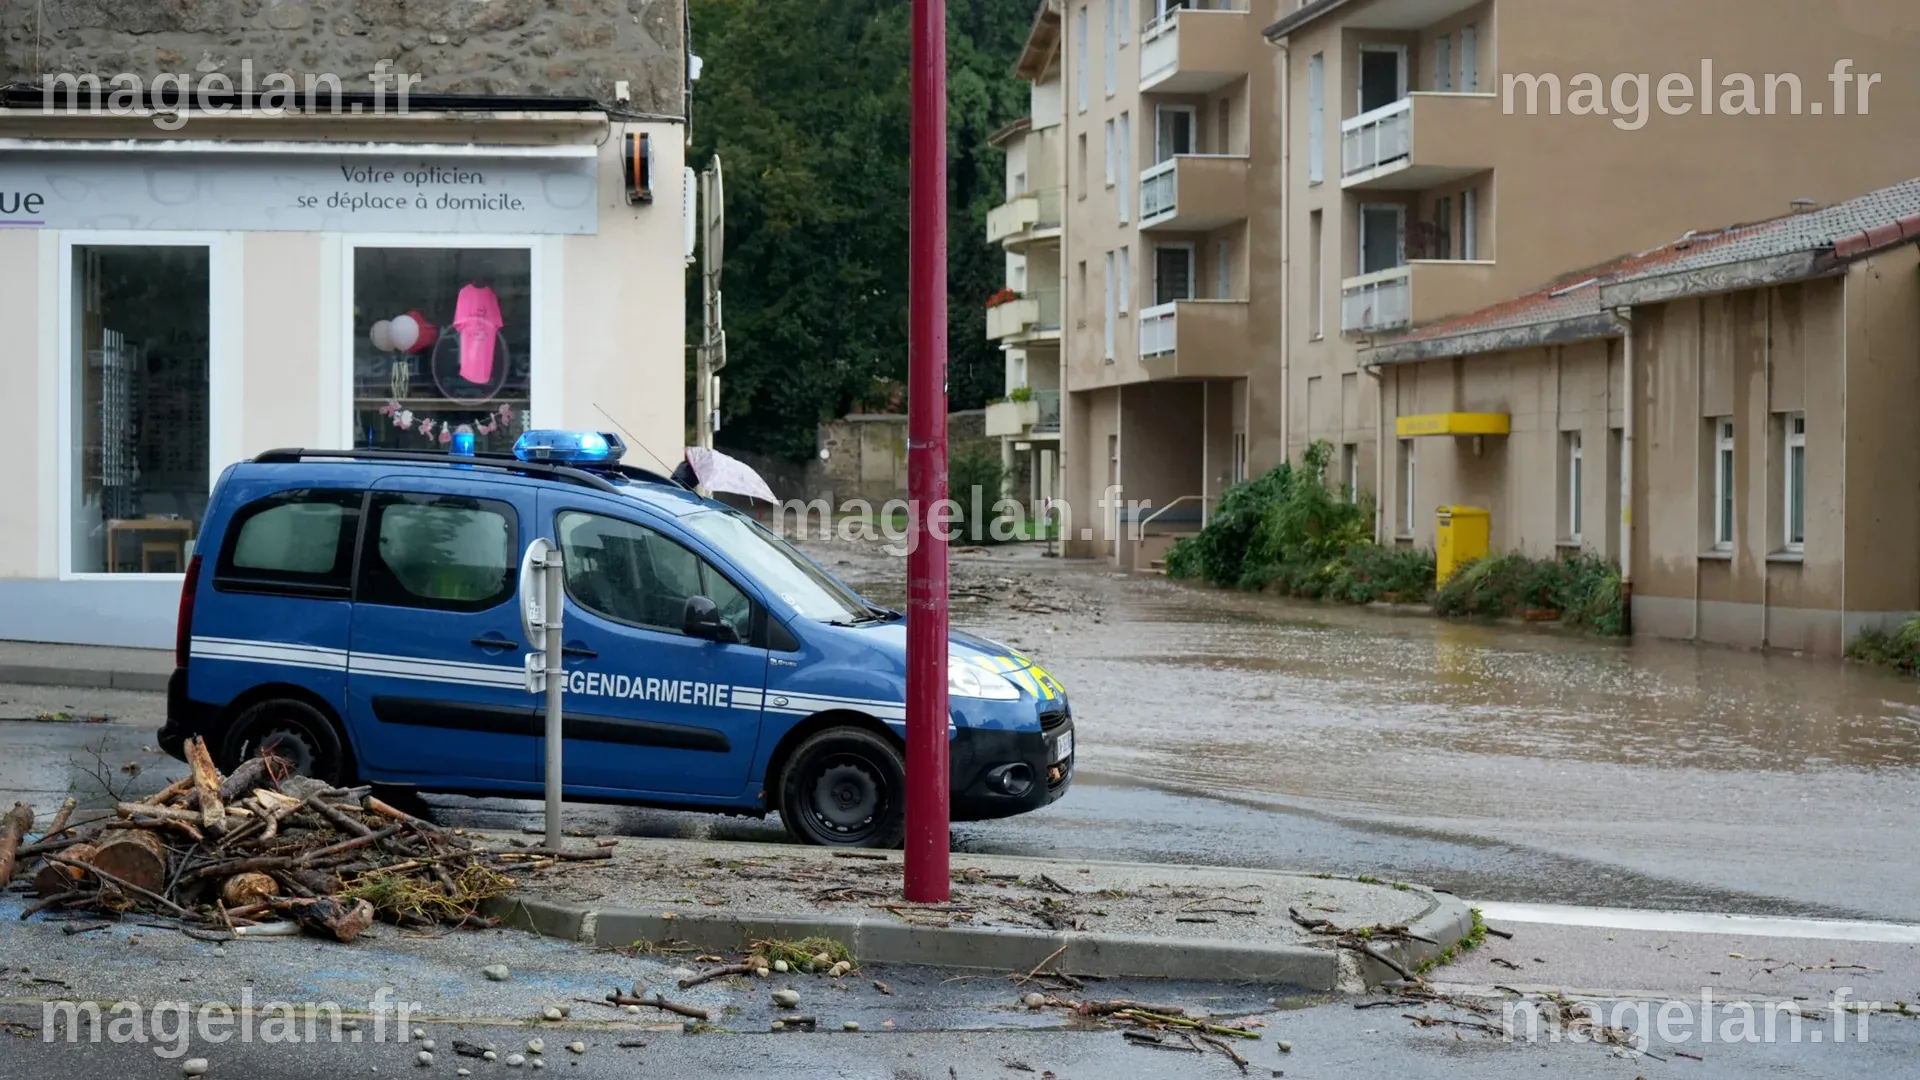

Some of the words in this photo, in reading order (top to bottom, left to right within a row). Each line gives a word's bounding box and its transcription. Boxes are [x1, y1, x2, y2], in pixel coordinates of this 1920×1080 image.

[340, 165, 395, 184] Votre
[403, 166, 483, 187] opticien
[0, 191, 45, 214] ue
[297, 196, 319, 209] se
[326, 191, 407, 212] déplace
[415, 193, 428, 210] à
[436, 192, 526, 211] domicile.
[569, 671, 730, 708] GENDARMERIE
